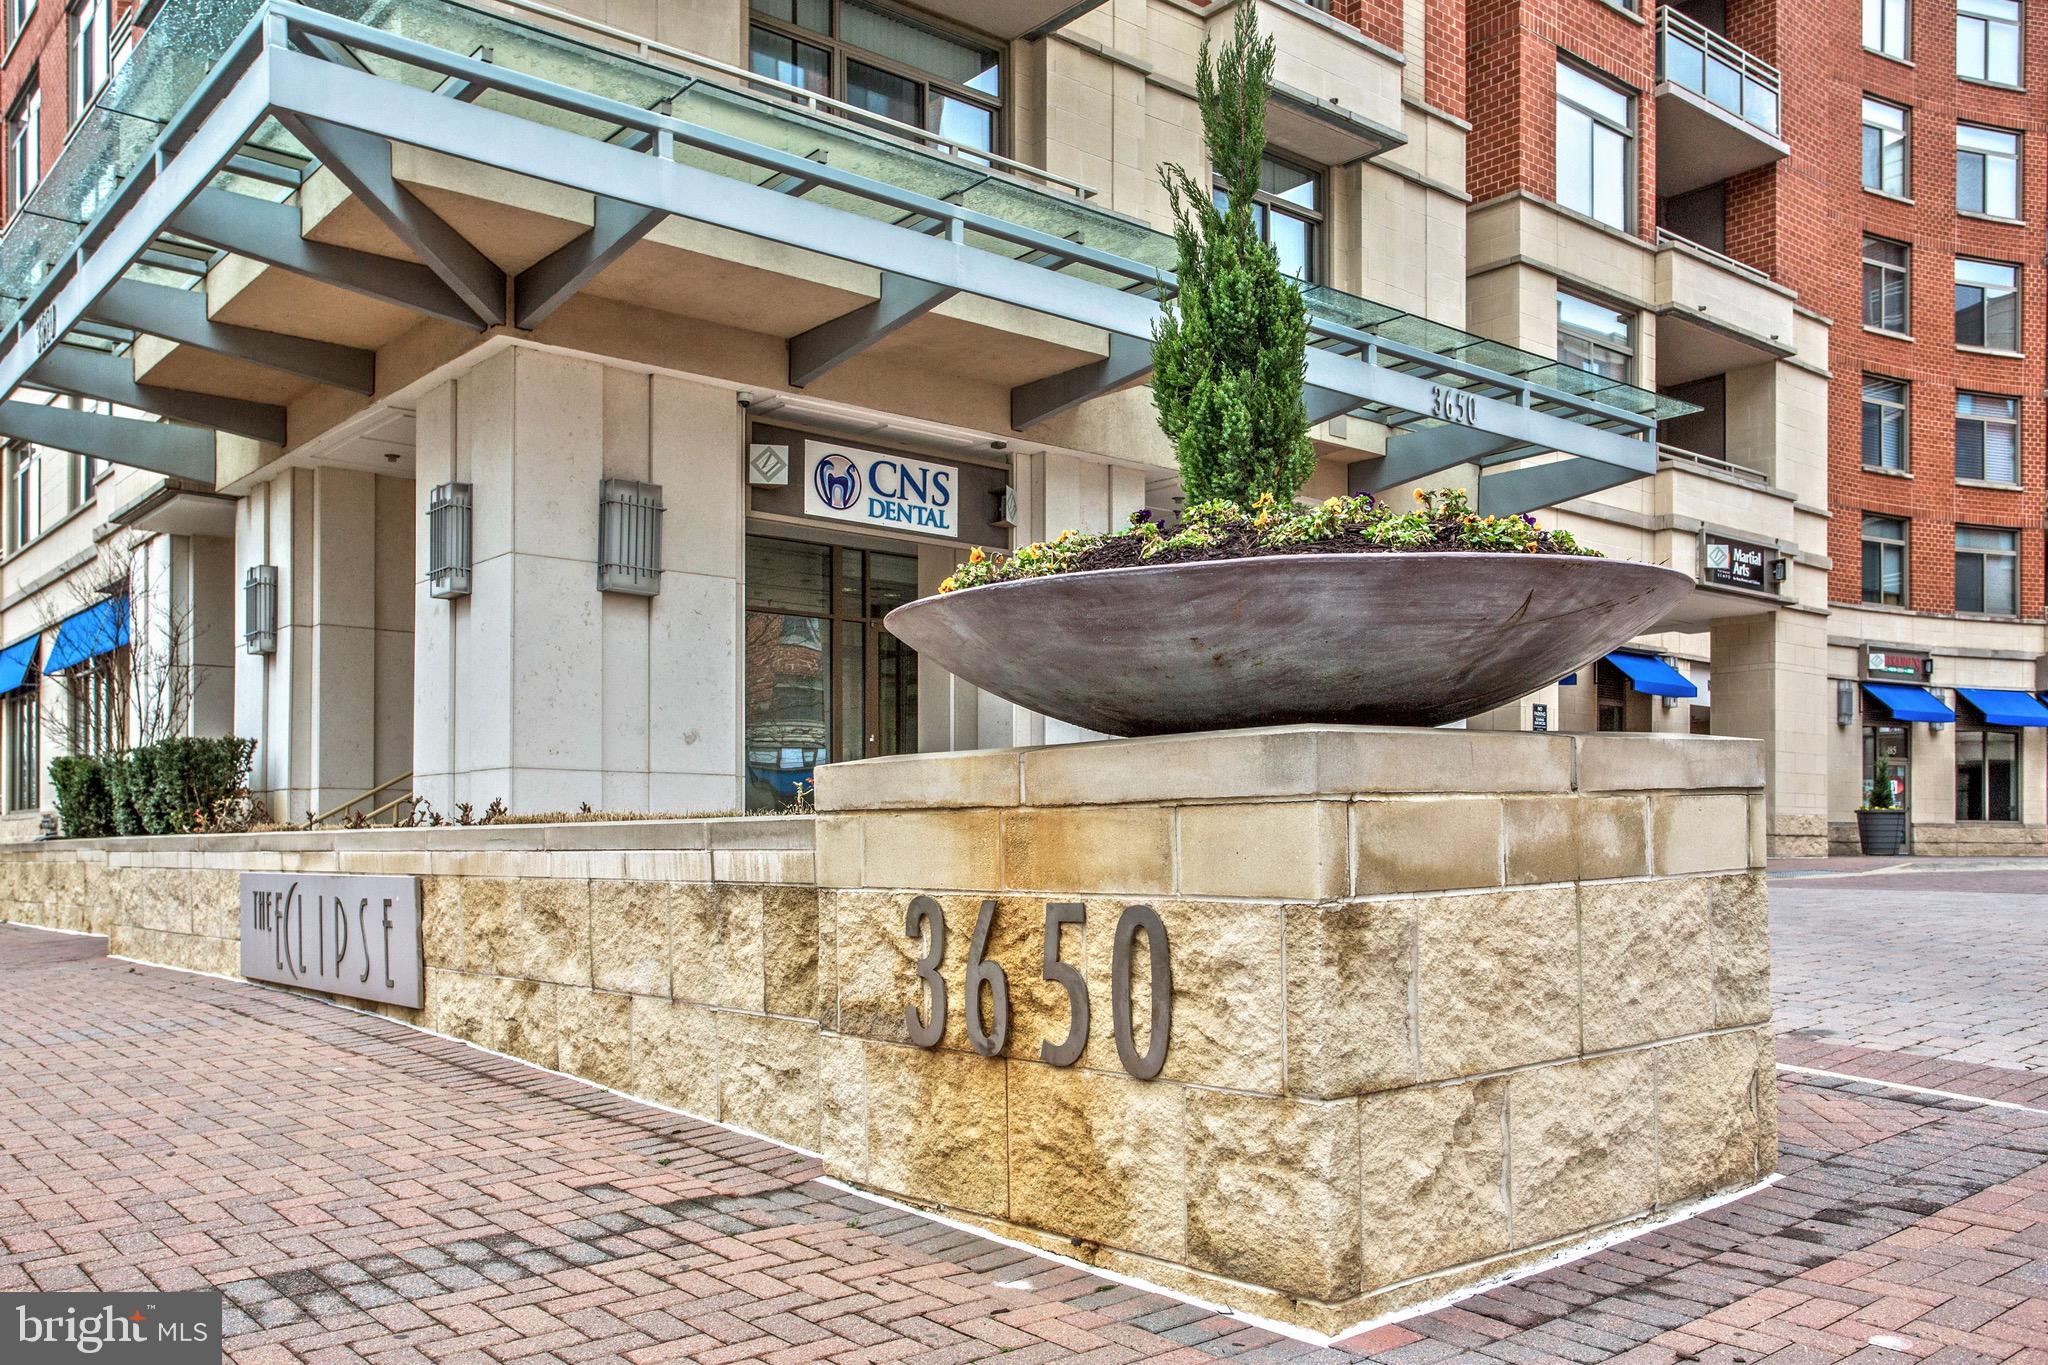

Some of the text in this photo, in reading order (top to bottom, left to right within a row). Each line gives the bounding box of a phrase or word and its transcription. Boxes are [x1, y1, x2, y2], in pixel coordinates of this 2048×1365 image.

[1431, 385, 1476, 425] 3650
[868, 460, 950, 507] CNS
[867, 497, 950, 529] DENTAL
[1733, 548, 1762, 566] Martial
[1733, 562, 1750, 577] Arts
[252, 882, 395, 988] THE ECLIPSE
[905, 895, 1173, 1081] 3650
